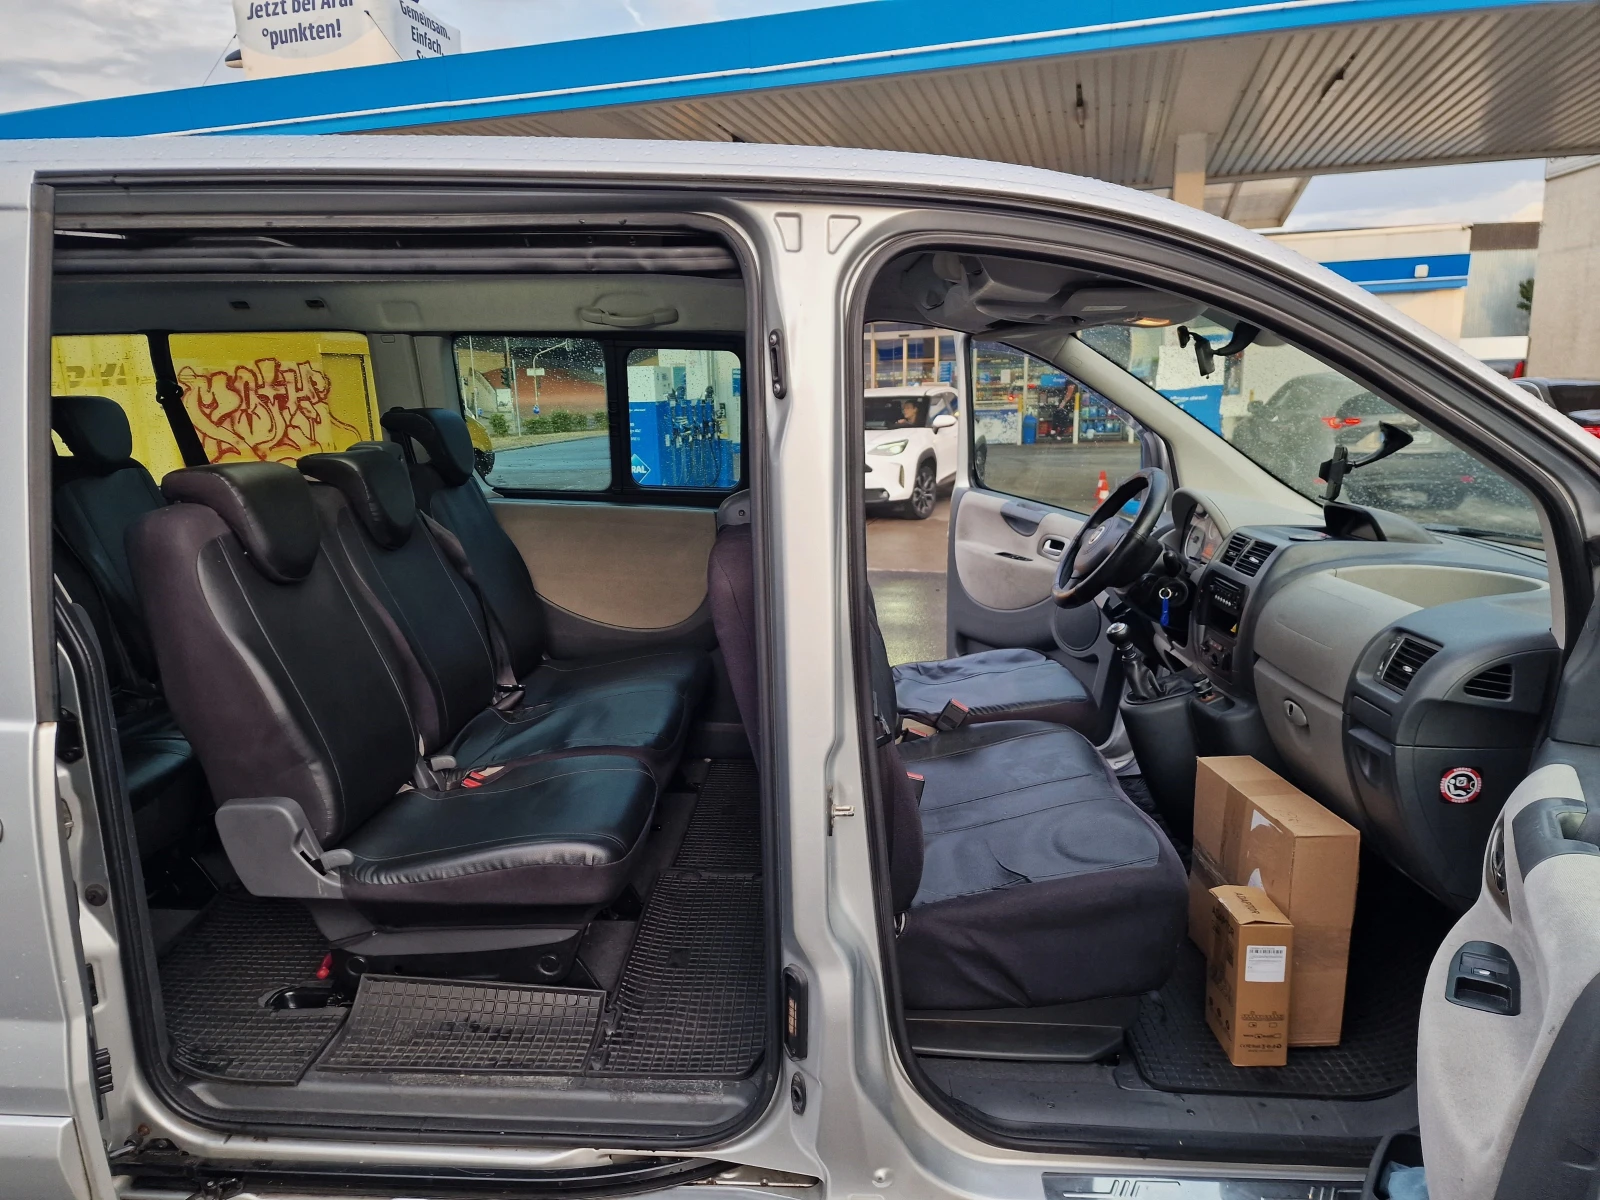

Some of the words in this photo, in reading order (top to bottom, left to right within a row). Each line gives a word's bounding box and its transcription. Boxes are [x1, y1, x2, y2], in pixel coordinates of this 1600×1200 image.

[247, 0, 288, 20] Jetzt
[292, 0, 316, 13] bei
[399, 0, 451, 40] Gemeinsam.
